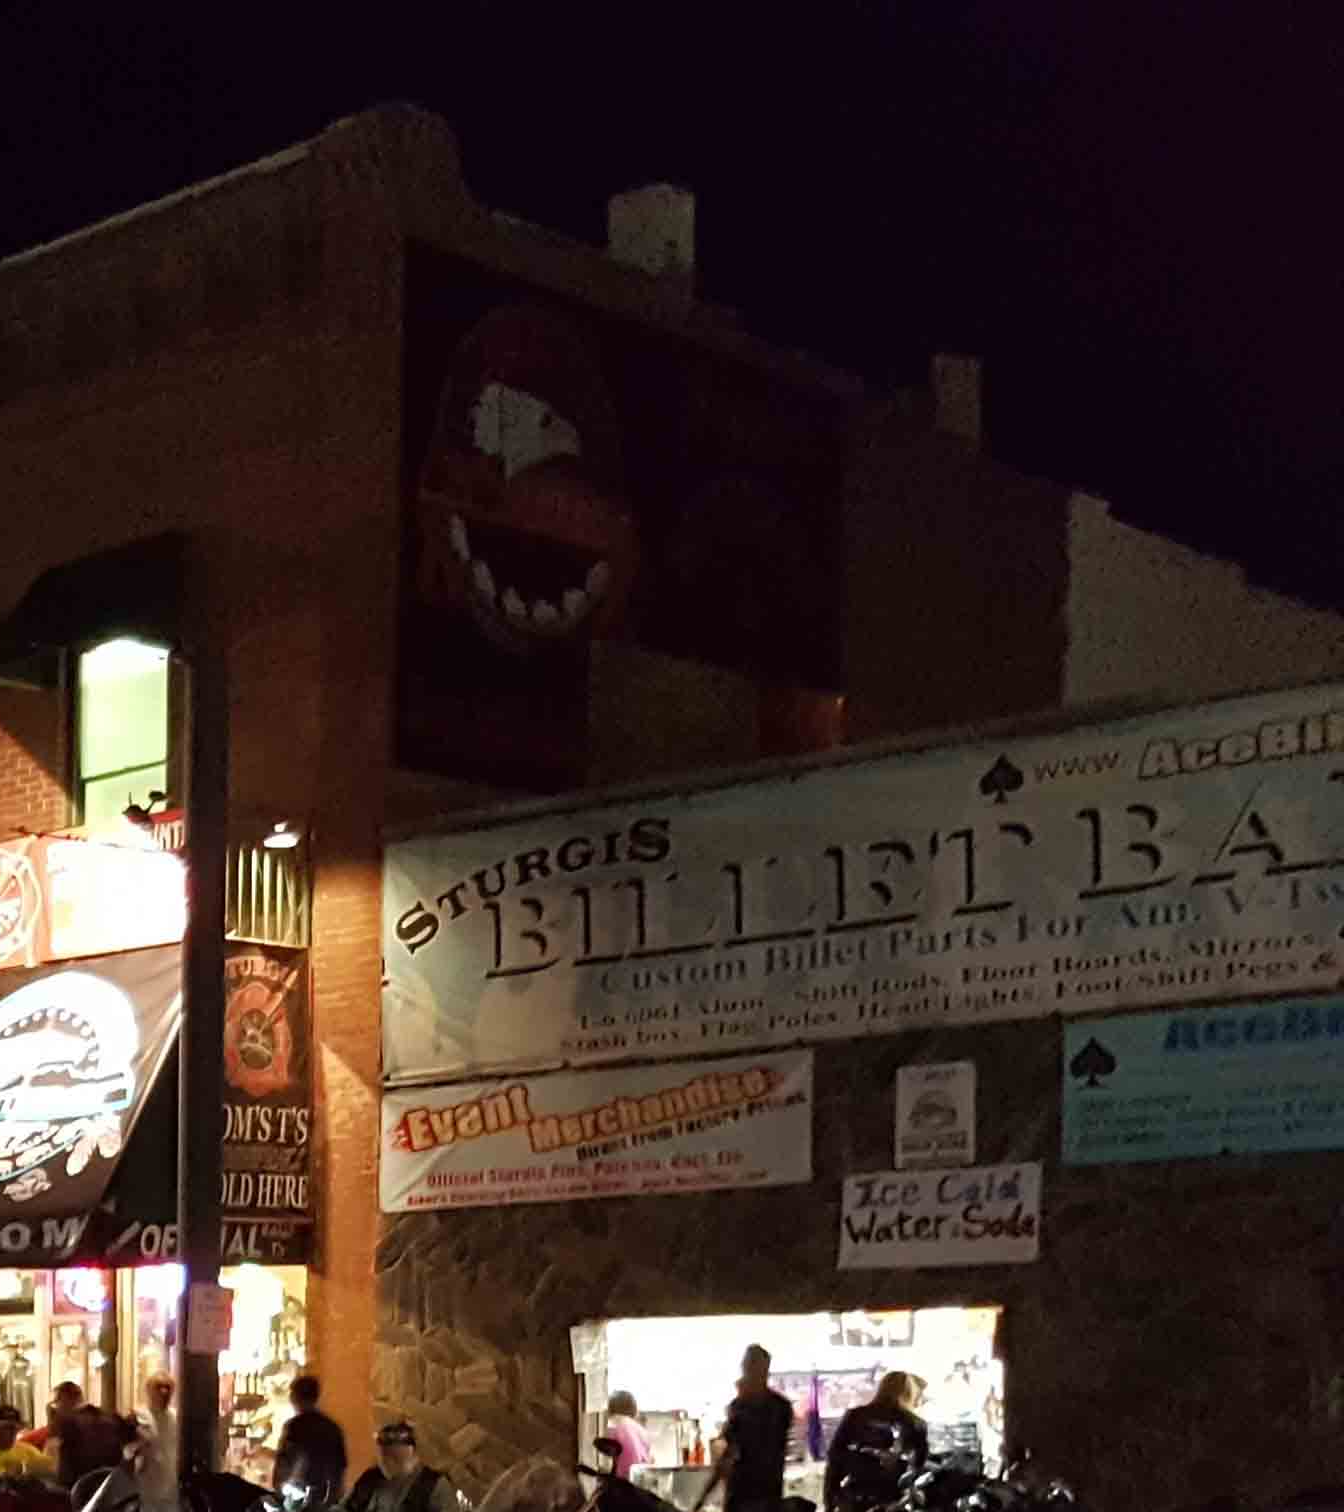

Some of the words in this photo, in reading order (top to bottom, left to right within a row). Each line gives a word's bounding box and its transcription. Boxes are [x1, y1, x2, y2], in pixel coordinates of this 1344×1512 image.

[1074, 766, 1344, 900] BA
[395, 816, 673, 956] STURGIS
[600, 957, 749, 996] Custom
[763, 935, 868, 977] Billet
[888, 922, 999, 960] Parts
[1015, 910, 1089, 944] For
[223, 1103, 273, 1145] M'S
[276, 1106, 309, 1146] T'S
[256, 1172, 309, 1209] HERE
[852, 1176, 922, 1211] Ice
[845, 1210, 948, 1244] Water
[961, 1201, 1037, 1241] Soda
